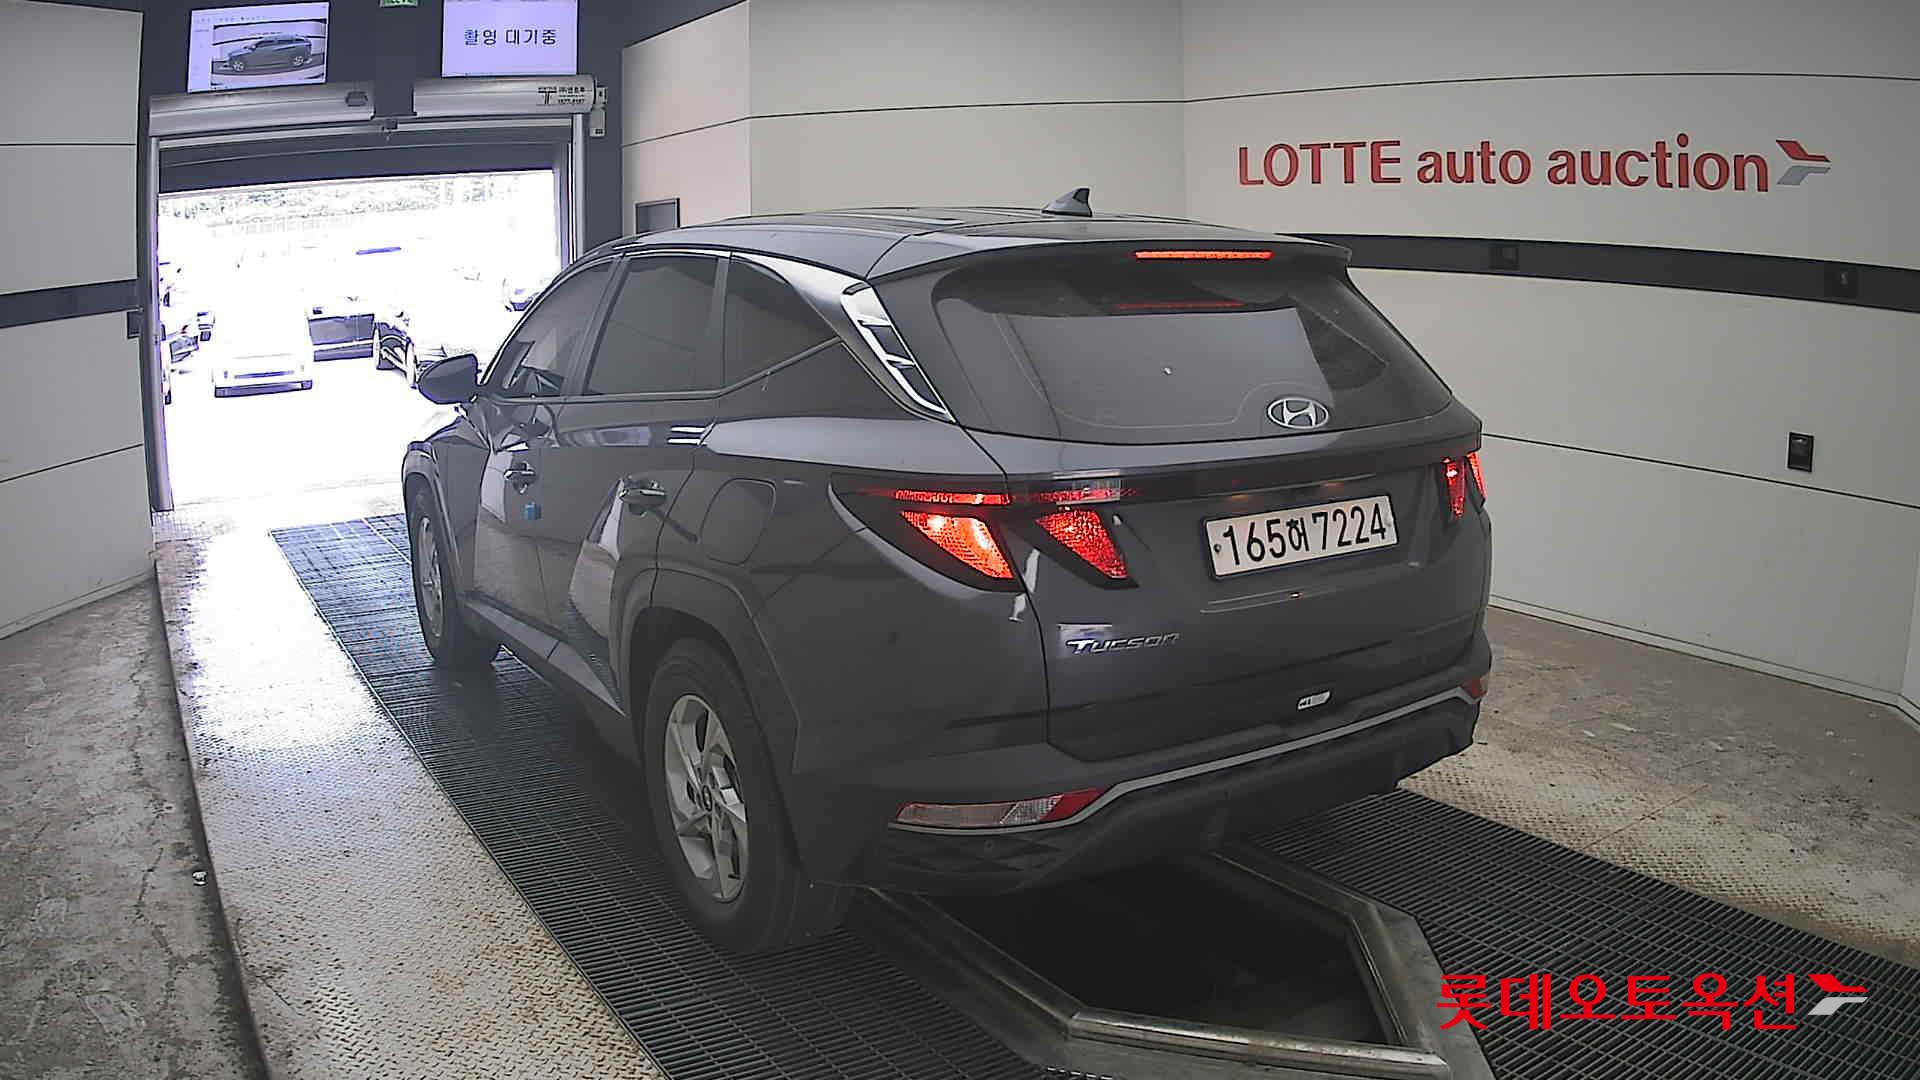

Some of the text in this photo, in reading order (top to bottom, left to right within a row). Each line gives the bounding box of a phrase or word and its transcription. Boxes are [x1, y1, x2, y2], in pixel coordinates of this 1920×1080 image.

[505, 29, 557, 45] 대기중
[1239, 134, 1769, 191] LOTTE auto auction
